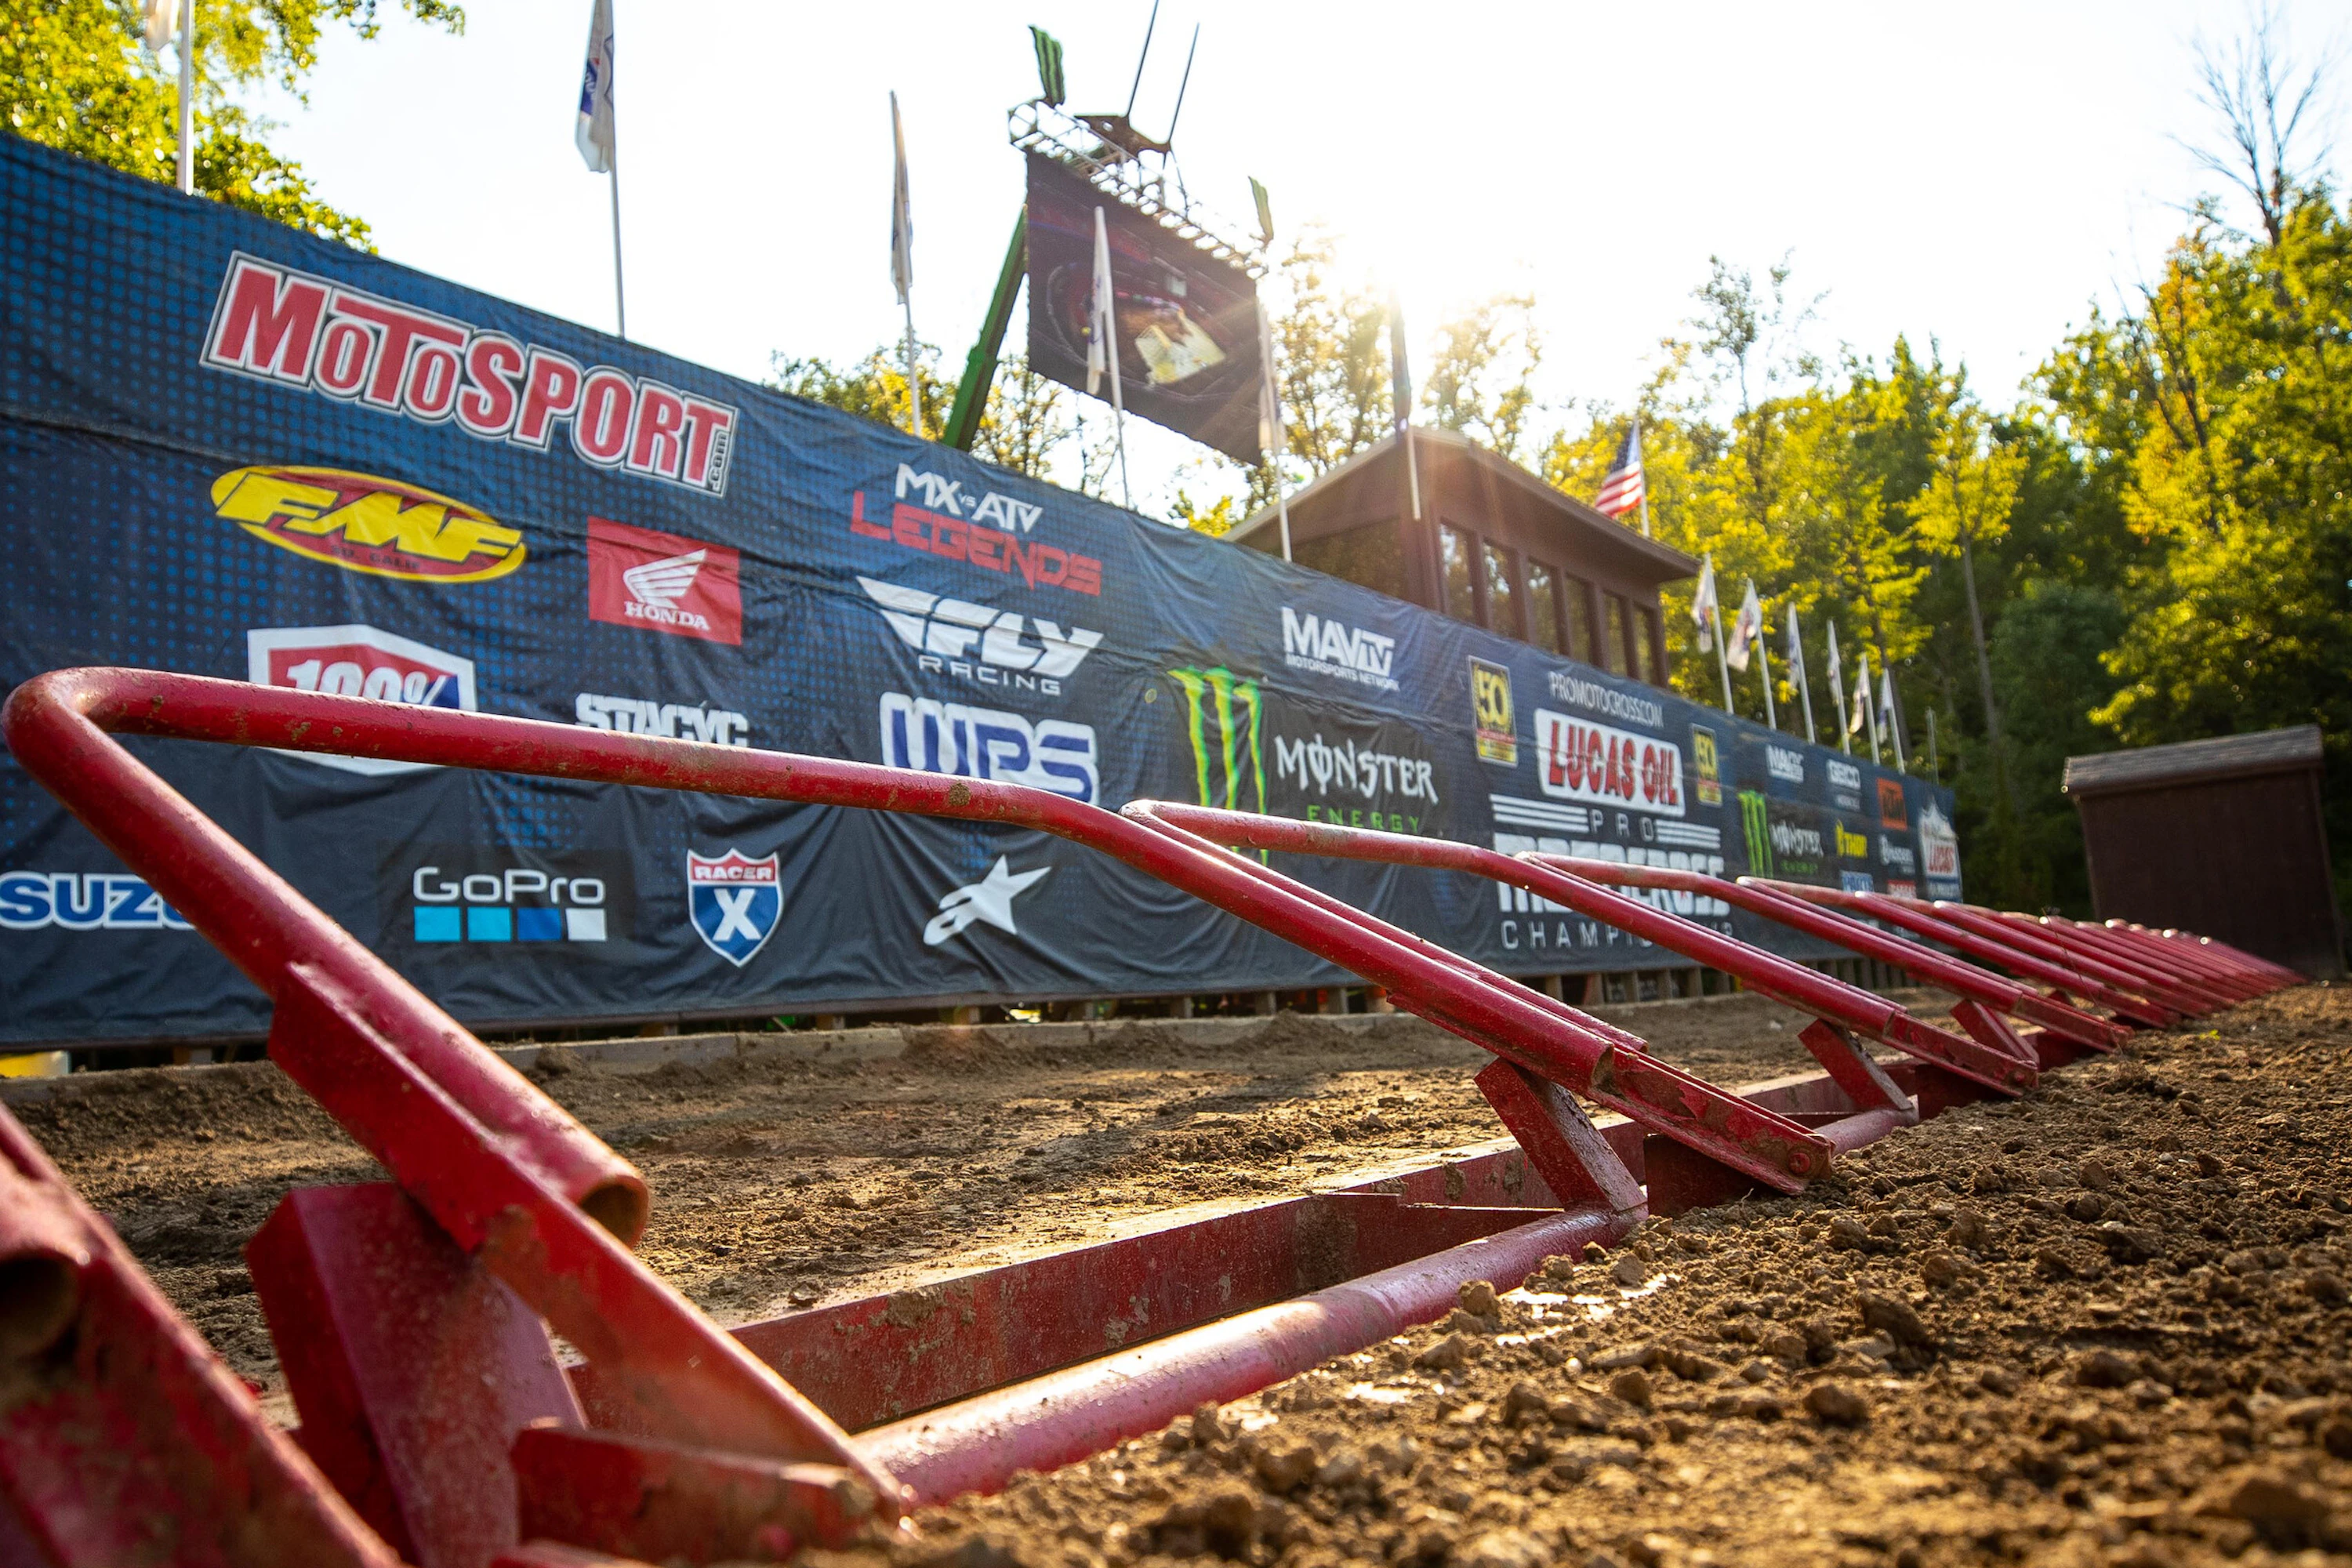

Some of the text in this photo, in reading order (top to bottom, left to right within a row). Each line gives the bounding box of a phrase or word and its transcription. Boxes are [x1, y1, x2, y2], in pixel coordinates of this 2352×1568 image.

[215, 472, 523, 563] FMF
[895, 463, 962, 515] MX
[971, 491, 1044, 532] ATV
[851, 490, 1102, 596] LEGENDS
[624, 601, 710, 630] HONDA
[919, 592, 1104, 677] FLY
[918, 654, 1062, 696] RACING
[1475, 668, 1510, 725] 50
[879, 691, 1098, 805] WPS
[1274, 732, 1440, 805] MONSTER
[1548, 720, 1636, 801] LUCAS
[1641, 742, 1679, 806] OIL
[1306, 804, 1421, 833] ENERGY
[1591, 808, 1656, 842] PRO
[0, 871, 198, 930] SUZ
[412, 866, 606, 905] GoPro
[693, 866, 773, 882] RACER
[710, 887, 757, 941] X
